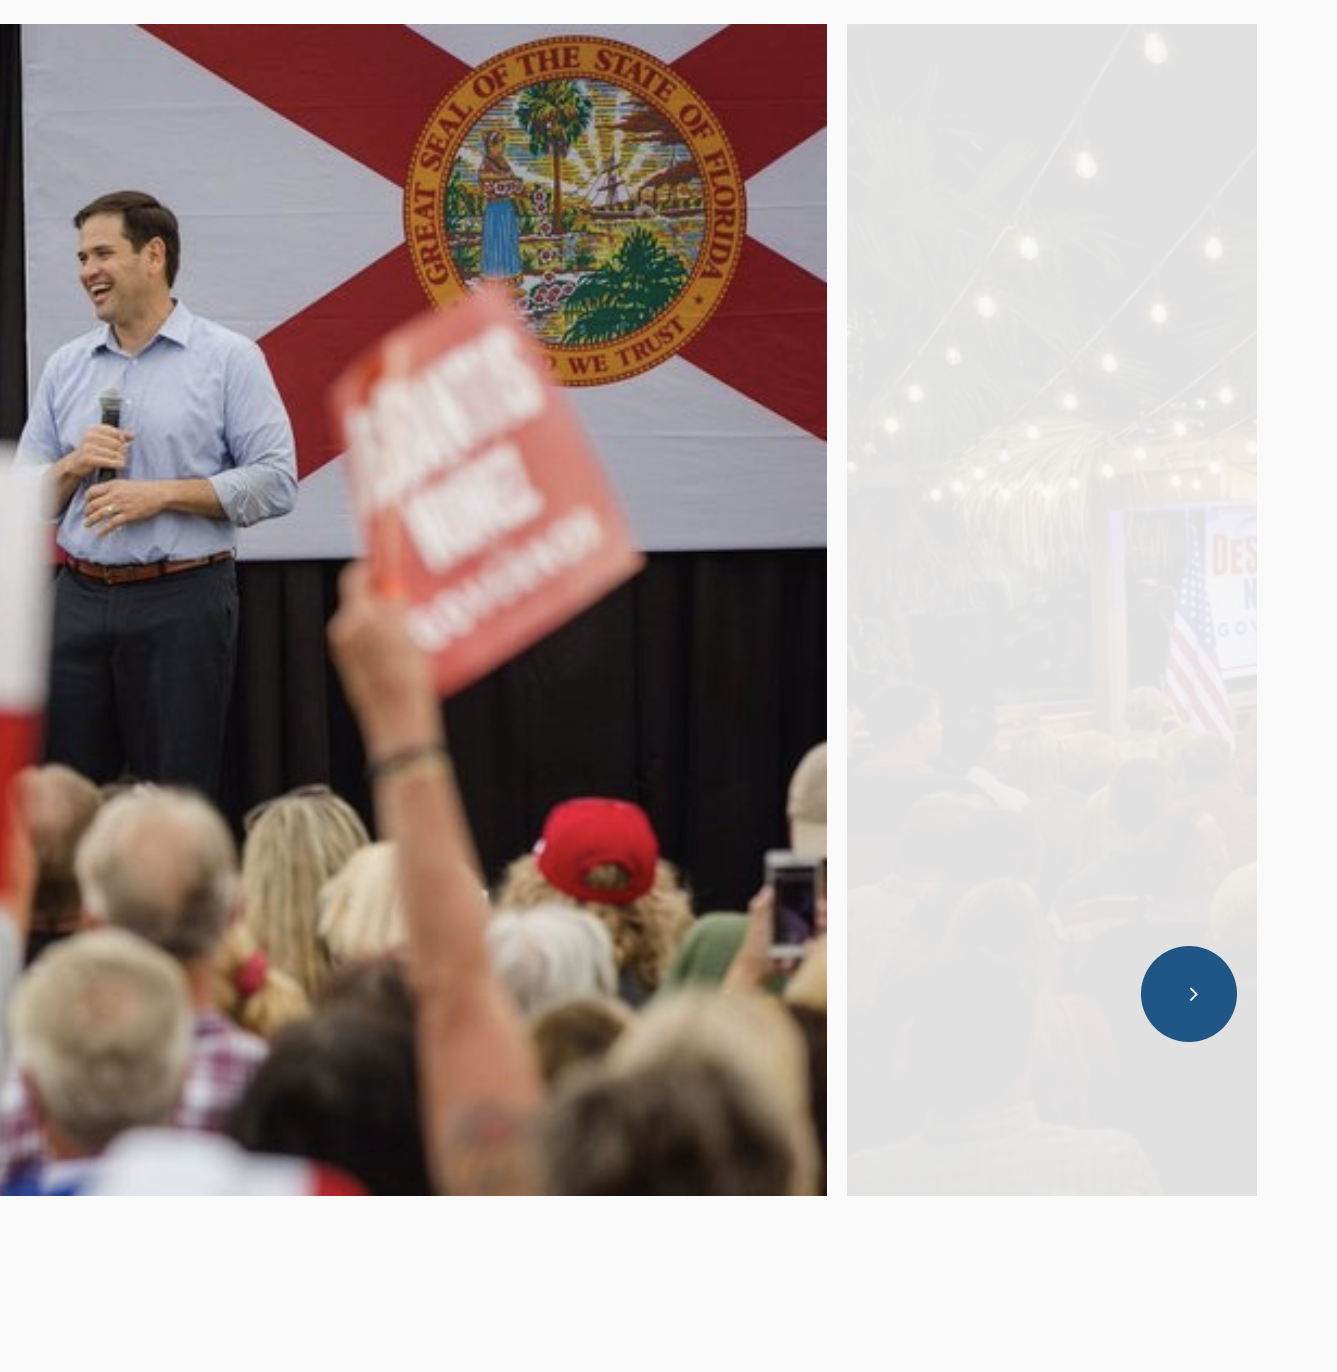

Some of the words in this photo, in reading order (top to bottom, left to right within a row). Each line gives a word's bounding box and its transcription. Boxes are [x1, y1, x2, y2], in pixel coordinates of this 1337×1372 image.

[472, 63, 510, 99] OF
[516, 46, 580, 77] THE
[594, 47, 677, 103] STATE
[420, 101, 473, 172] SEAL
[679, 103, 715, 140] OF
[412, 182, 450, 285] GREAT
[700, 144, 736, 281] FLORIDA
[567, 353, 609, 375] WE
[618, 316, 686, 367] TRUST
